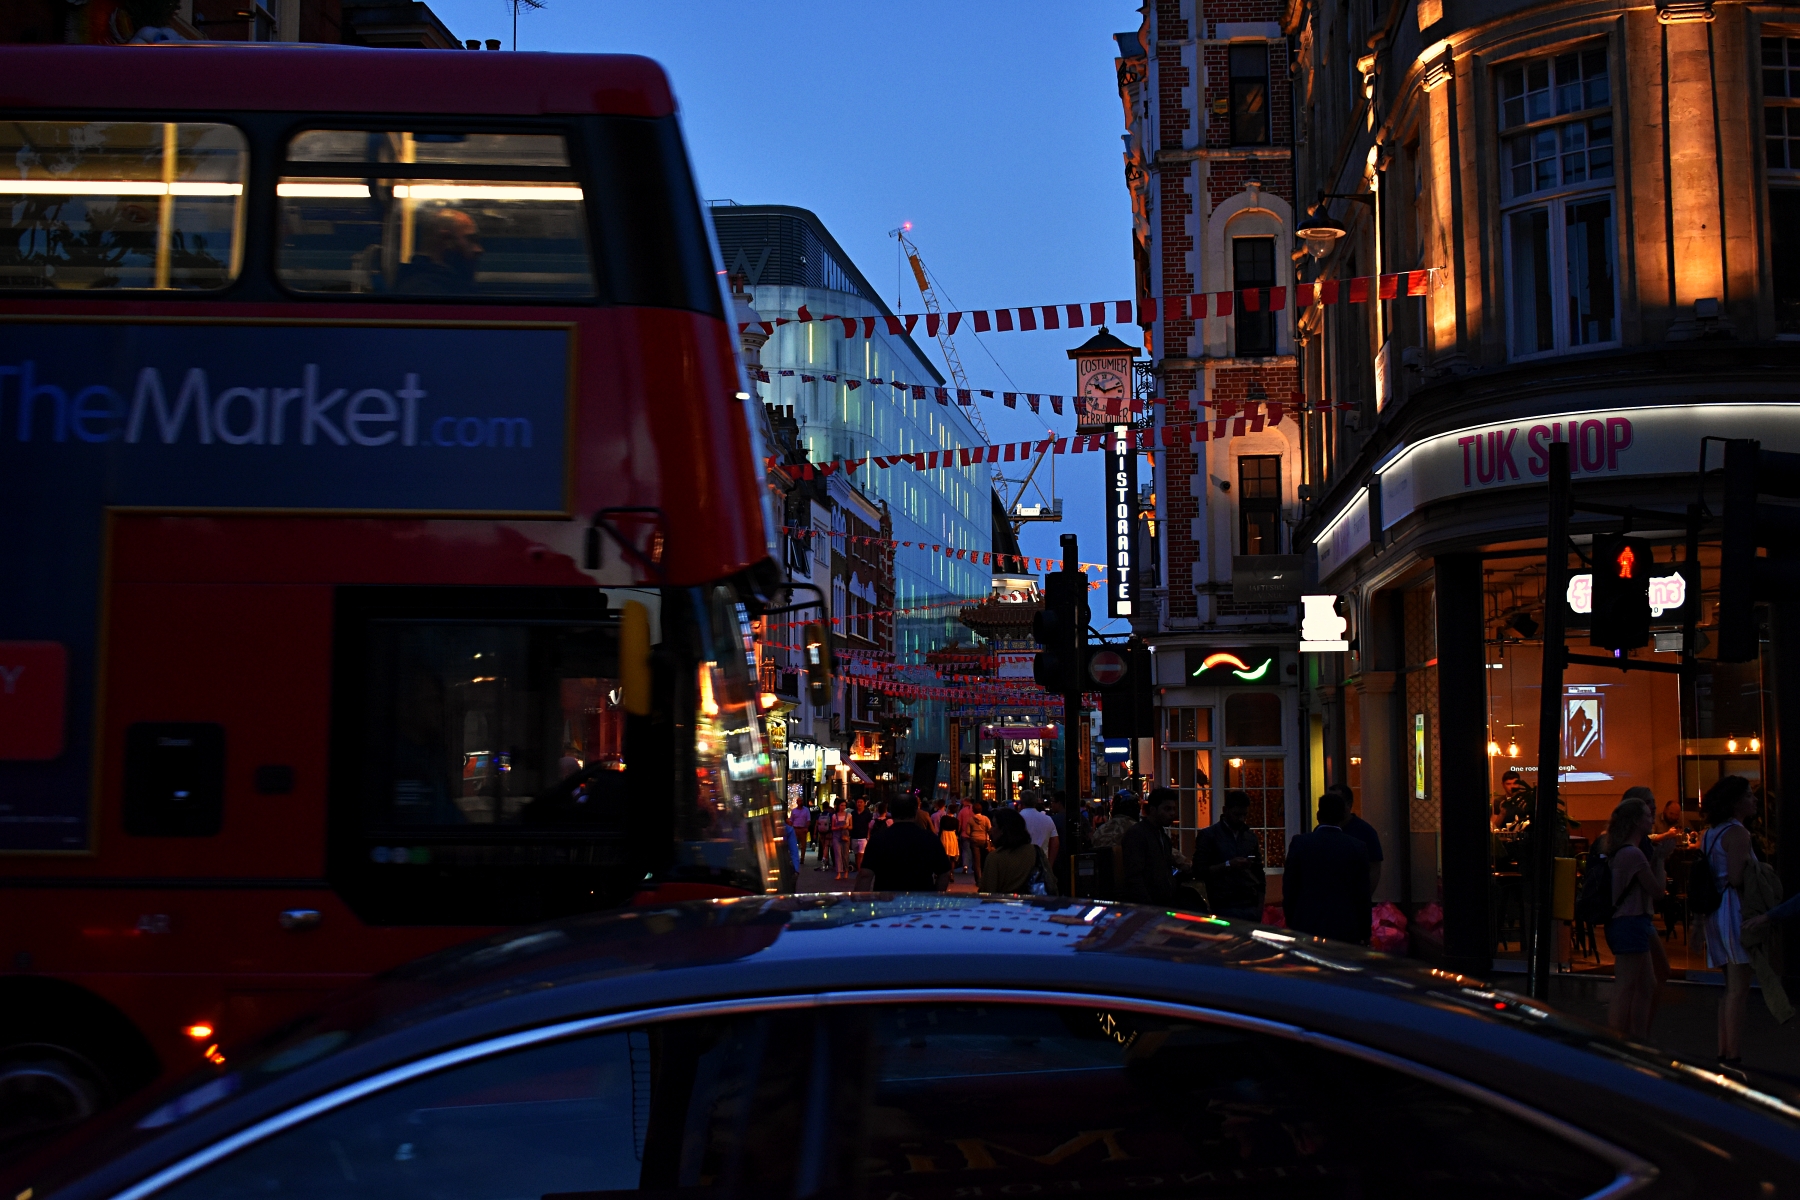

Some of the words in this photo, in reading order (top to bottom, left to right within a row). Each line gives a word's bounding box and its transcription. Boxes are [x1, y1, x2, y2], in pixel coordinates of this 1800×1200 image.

[1080, 358, 1128, 377] COSTUMIER
[1458, 428, 1520, 487] TUK
[1528, 417, 1633, 477] SHOP
[1115, 440, 1131, 599] RISTORANTE
[868, 696, 879, 705] 22
[1558, 764, 1577, 772] ough.
